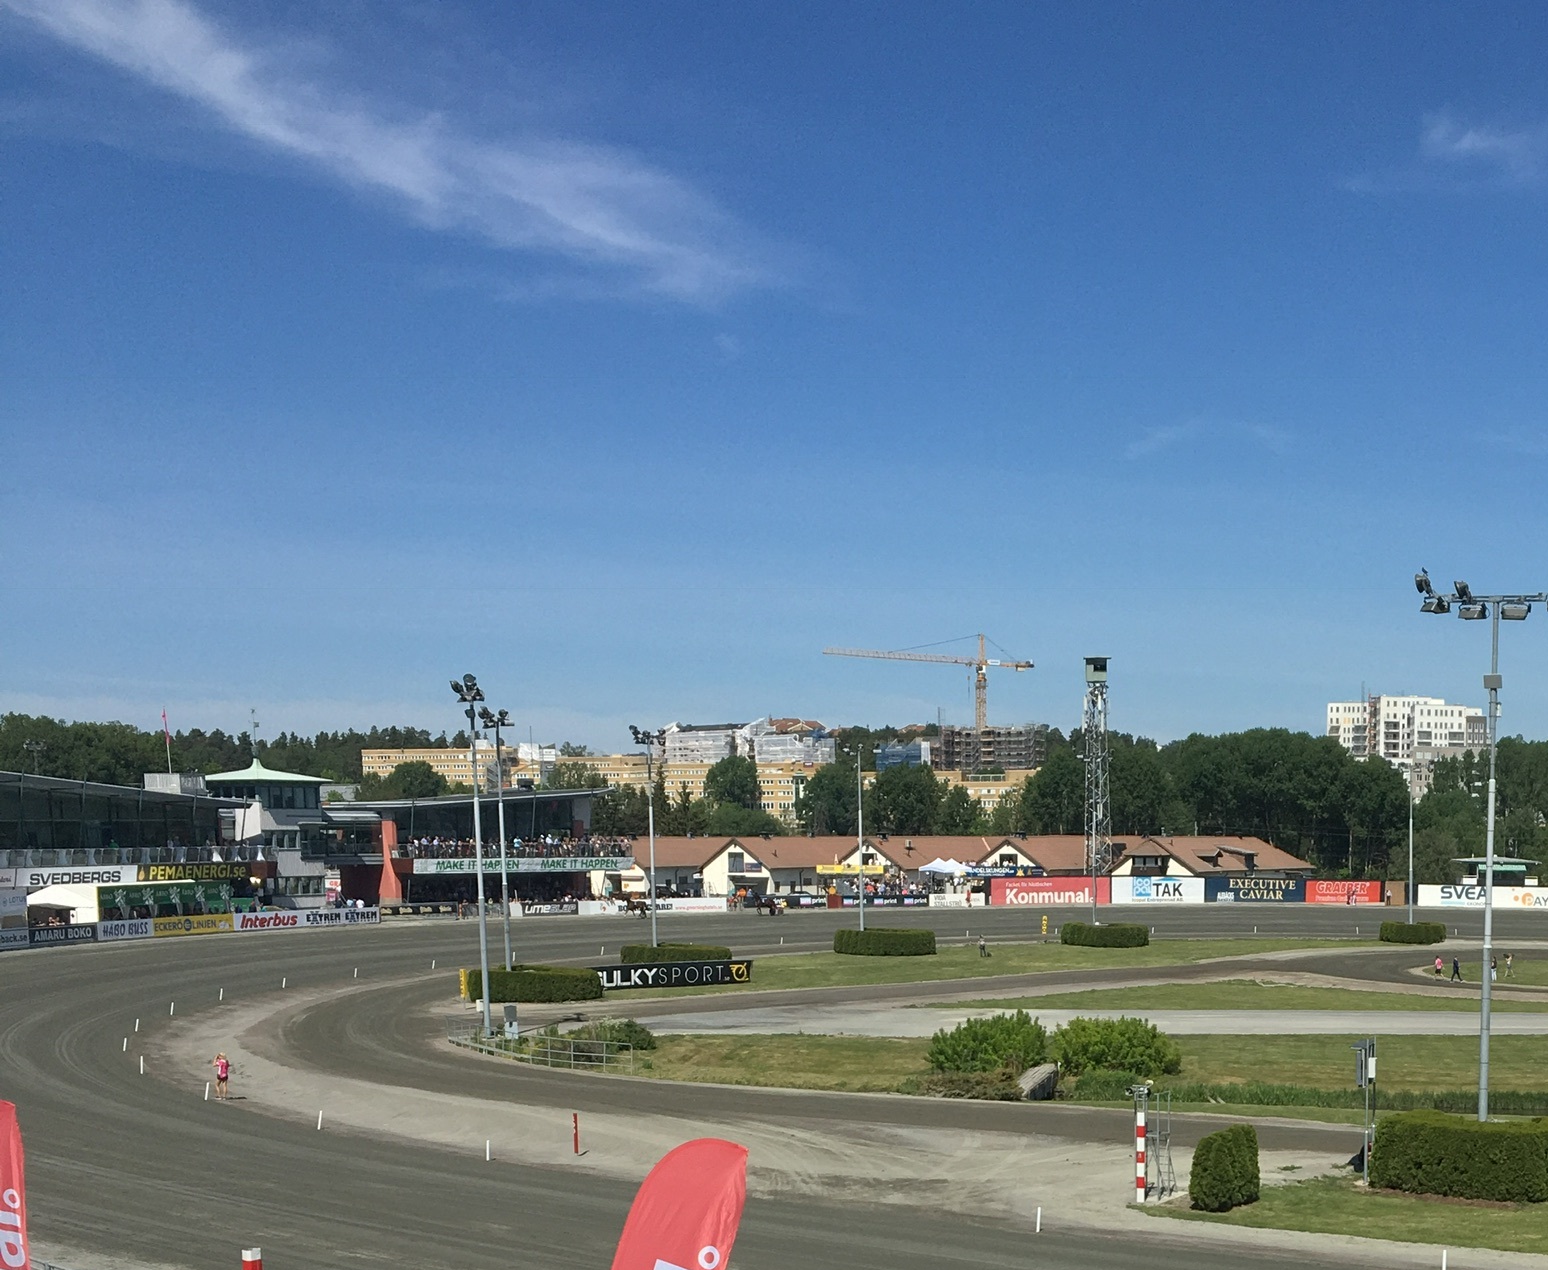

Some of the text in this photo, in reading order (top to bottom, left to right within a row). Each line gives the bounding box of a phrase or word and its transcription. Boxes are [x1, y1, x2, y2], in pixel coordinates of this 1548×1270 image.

[436, 860, 477, 870] MAKE IT
[541, 859, 618, 869] MAKE IT HAPPEN
[29, 871, 121, 885] SVEDBERGS
[149, 865, 246, 880] PEMAENERGI.se
[1153, 883, 1183, 897] TAK
[1229, 879, 1296, 890] EXECUTIVE
[1240, 890, 1284, 900] CAVIAR
[154, 919, 217, 932] ECKERÖ LINJEN
[241, 914, 298, 929] Interbus
[34, 926, 92, 942] AMARU BOKO
[128, 922, 148, 936] BUSS
